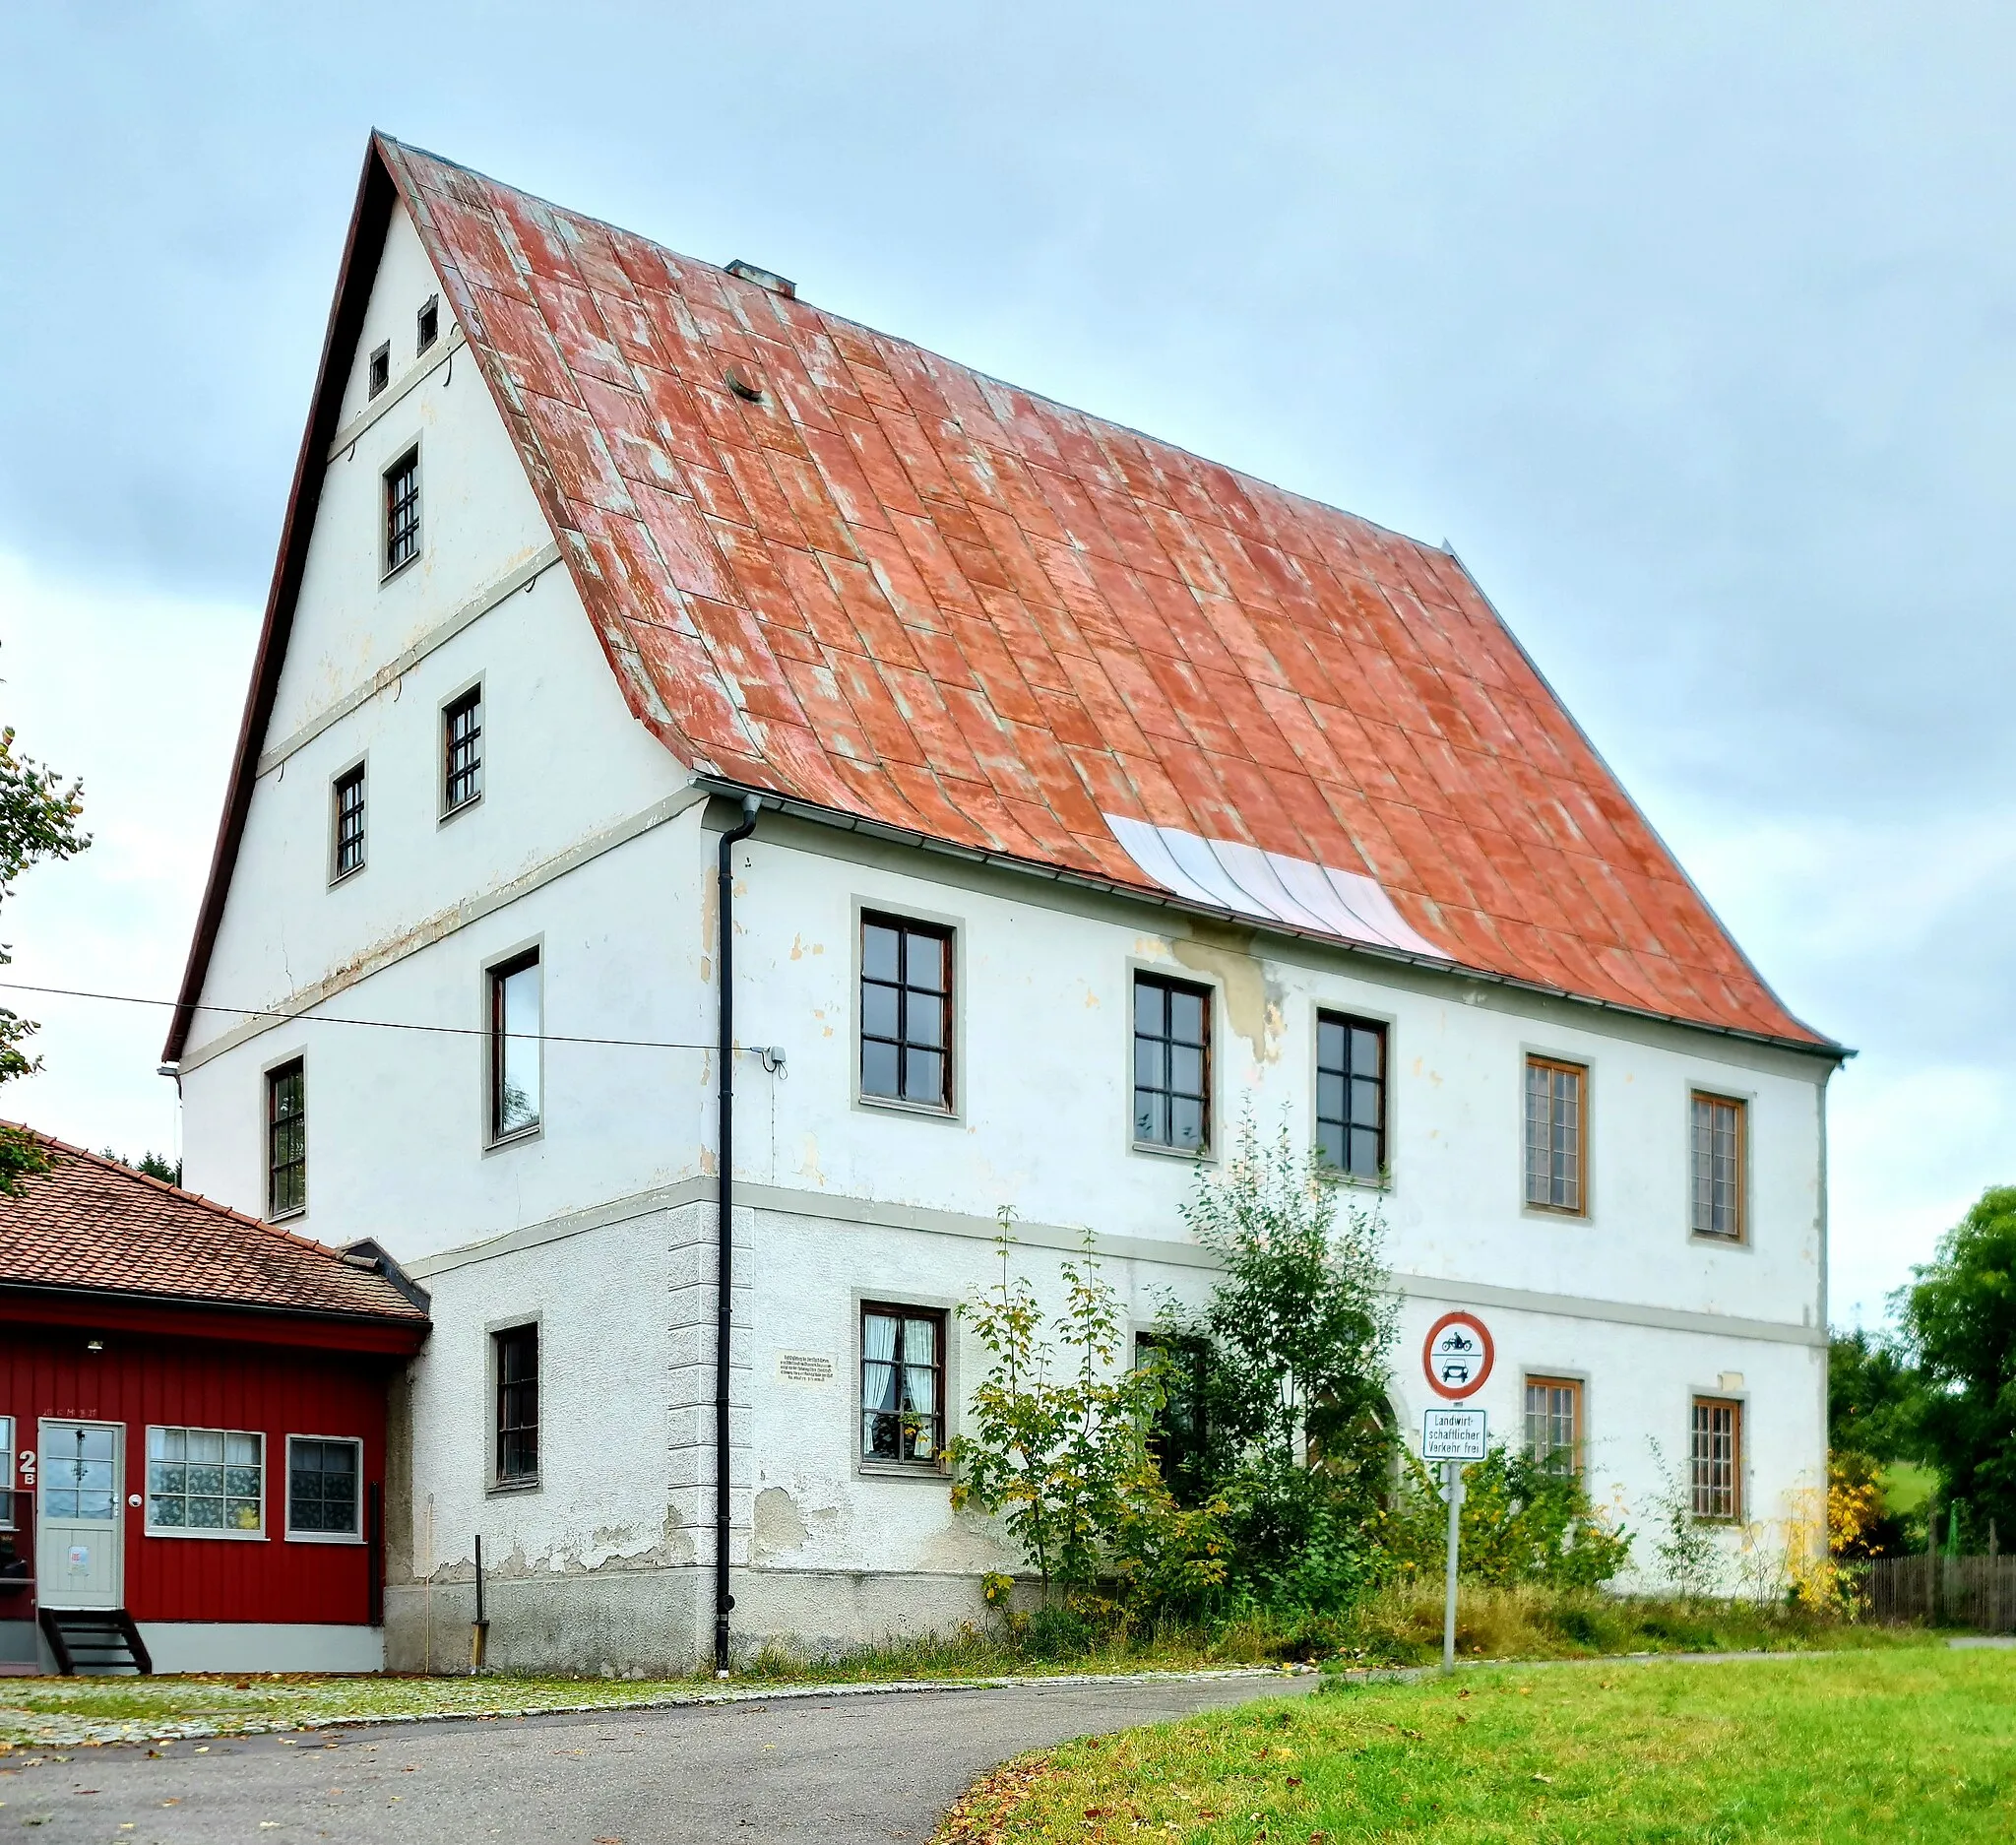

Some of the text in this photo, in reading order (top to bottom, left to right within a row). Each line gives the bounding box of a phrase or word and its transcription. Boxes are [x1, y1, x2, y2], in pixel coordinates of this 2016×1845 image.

[1434, 1414, 1474, 1427] Landwirt-
[1428, 1428, 1480, 1440] schaftlicher
[1428, 1440, 1480, 1454] Verkehr frei
[20, 1450, 36, 1473] 2
[24, 1473, 36, 1485] B
